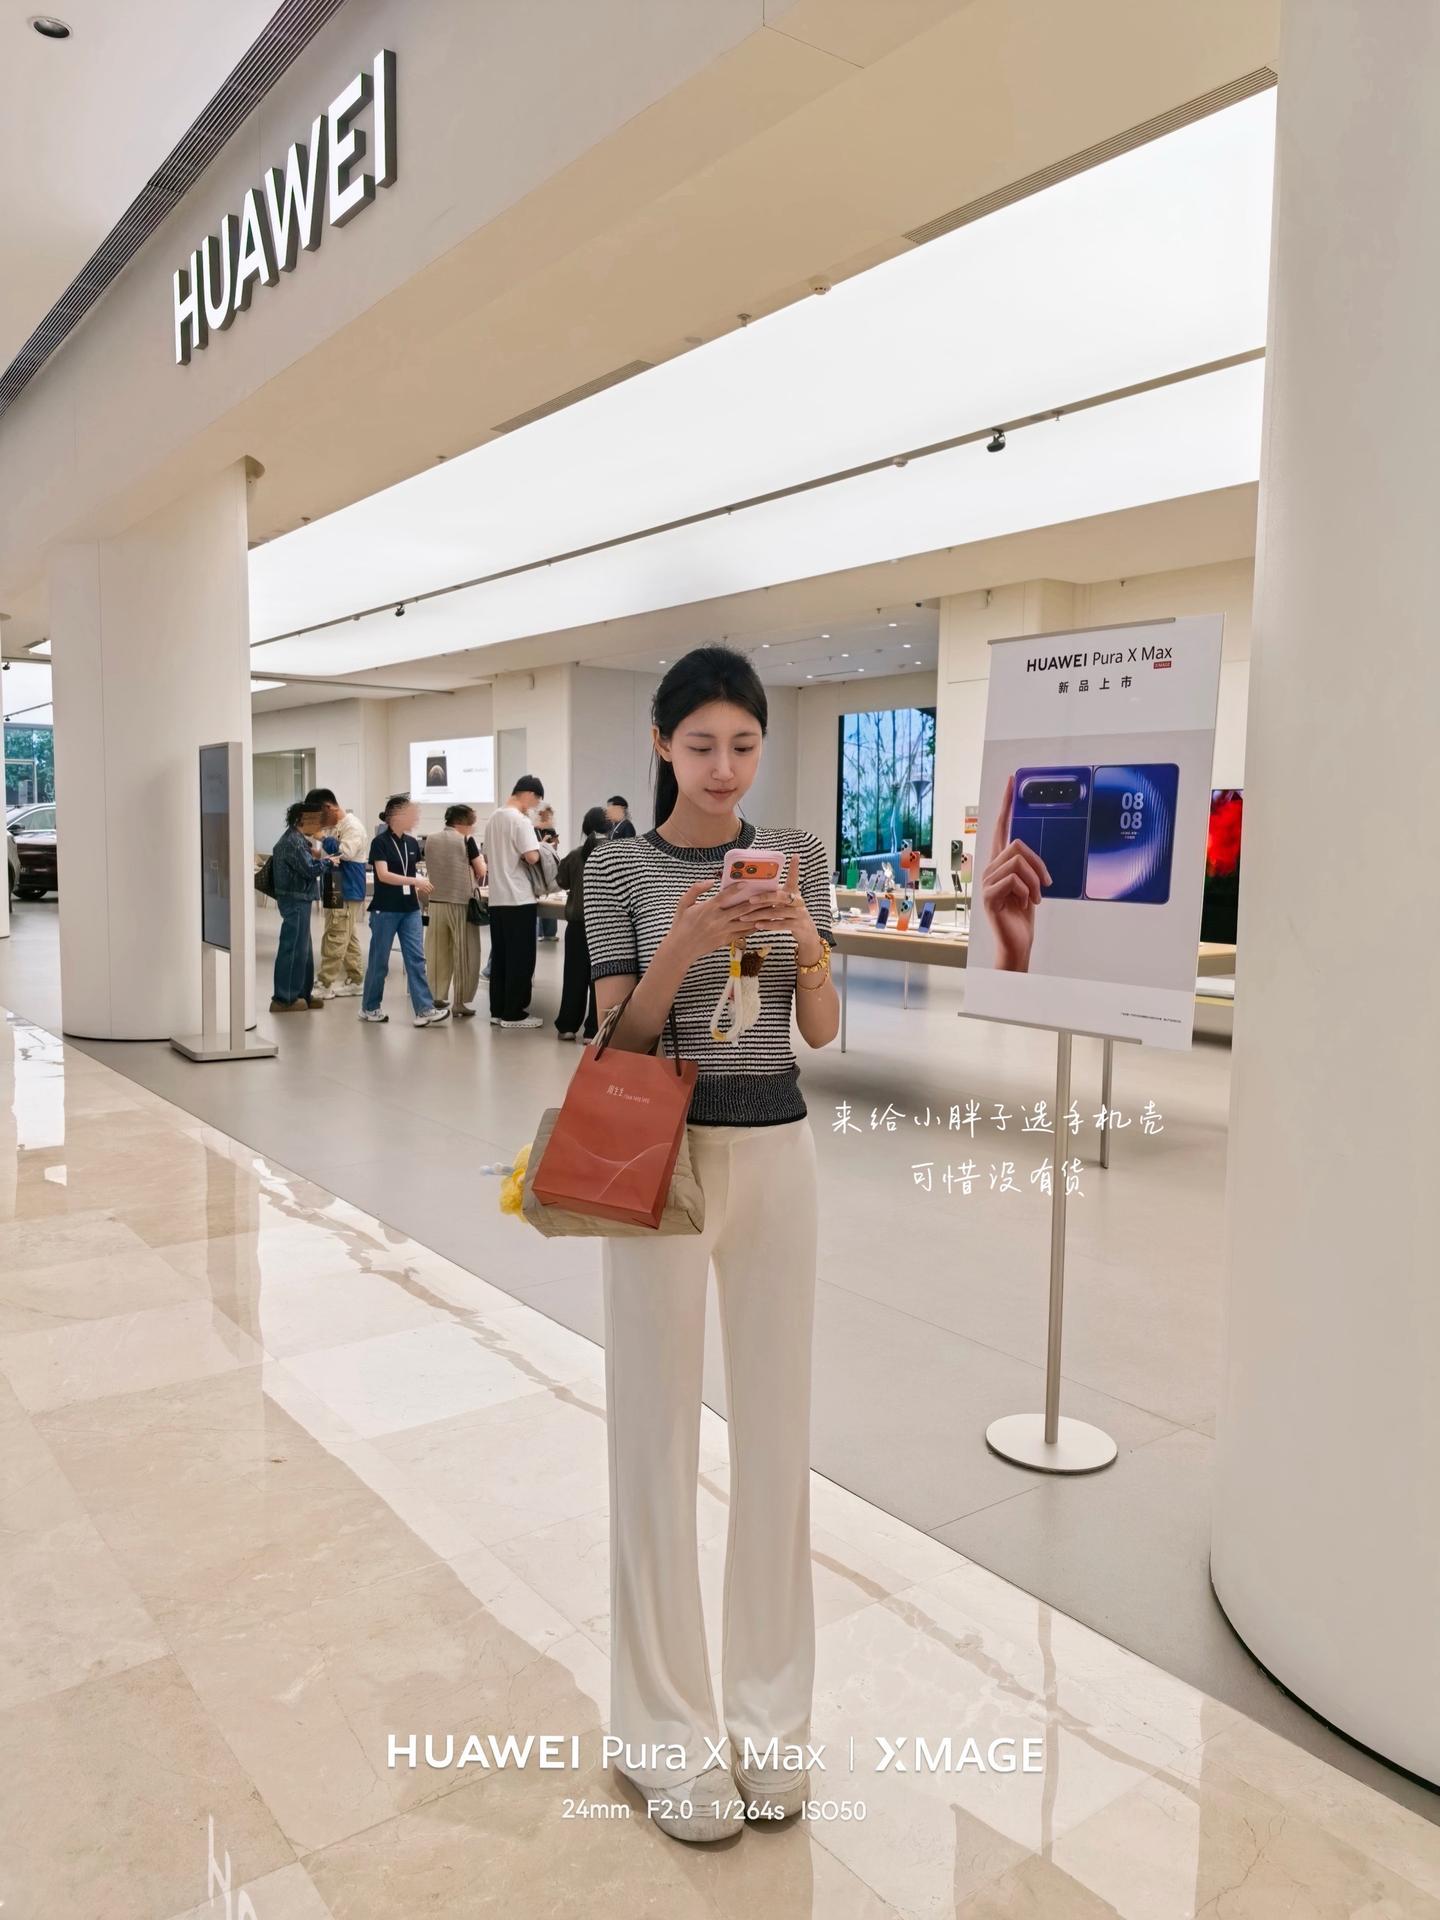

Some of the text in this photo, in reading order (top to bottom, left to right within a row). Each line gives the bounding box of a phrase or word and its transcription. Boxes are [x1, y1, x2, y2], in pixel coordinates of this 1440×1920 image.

[173, 48, 397, 365] HUAWEI
[1026, 646, 1173, 672] HUAWEI Pura X Max
[1058, 675, 1133, 694] 新品上市
[1121, 792, 1144, 810] 08
[1120, 811, 1143, 829] 08
